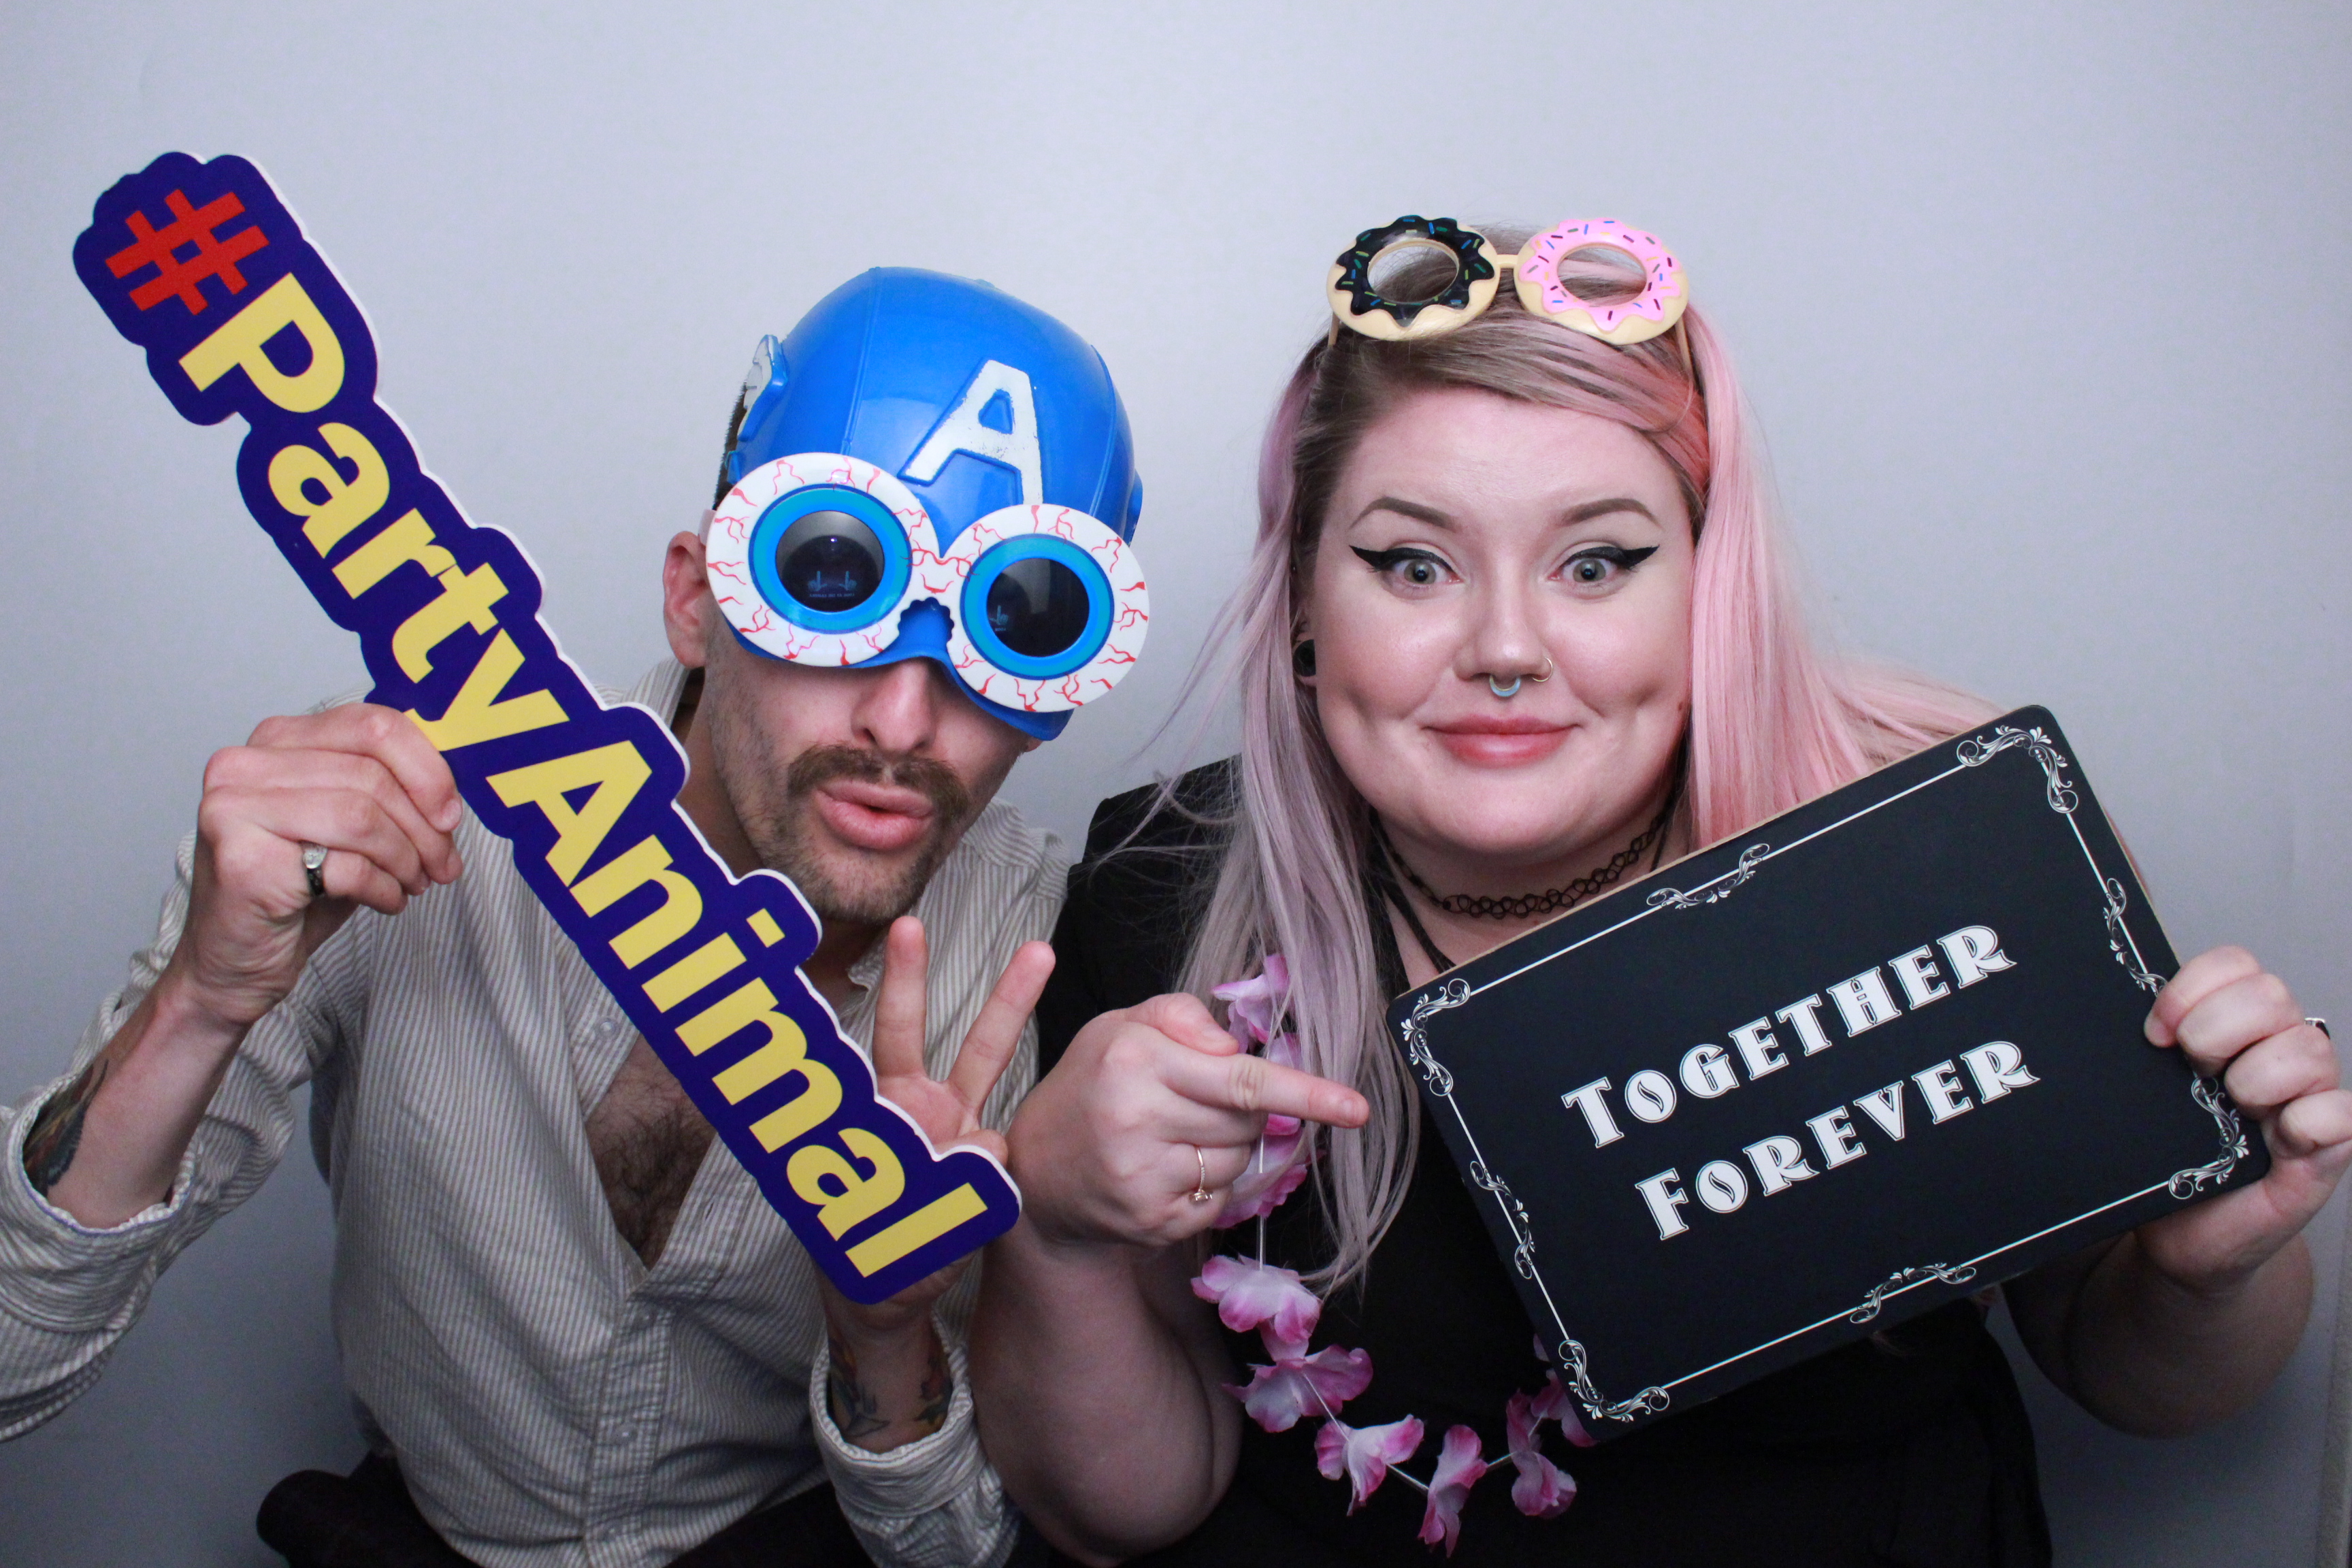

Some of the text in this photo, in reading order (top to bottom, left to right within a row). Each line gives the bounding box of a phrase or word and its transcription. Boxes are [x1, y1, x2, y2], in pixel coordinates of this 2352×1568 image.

[899, 359, 1044, 504] A
[105, 189, 988, 1278] #PartyAnimal
[1561, 925, 2018, 1148] TOGETHER
[1634, 1040, 2041, 1241] FOREVER
